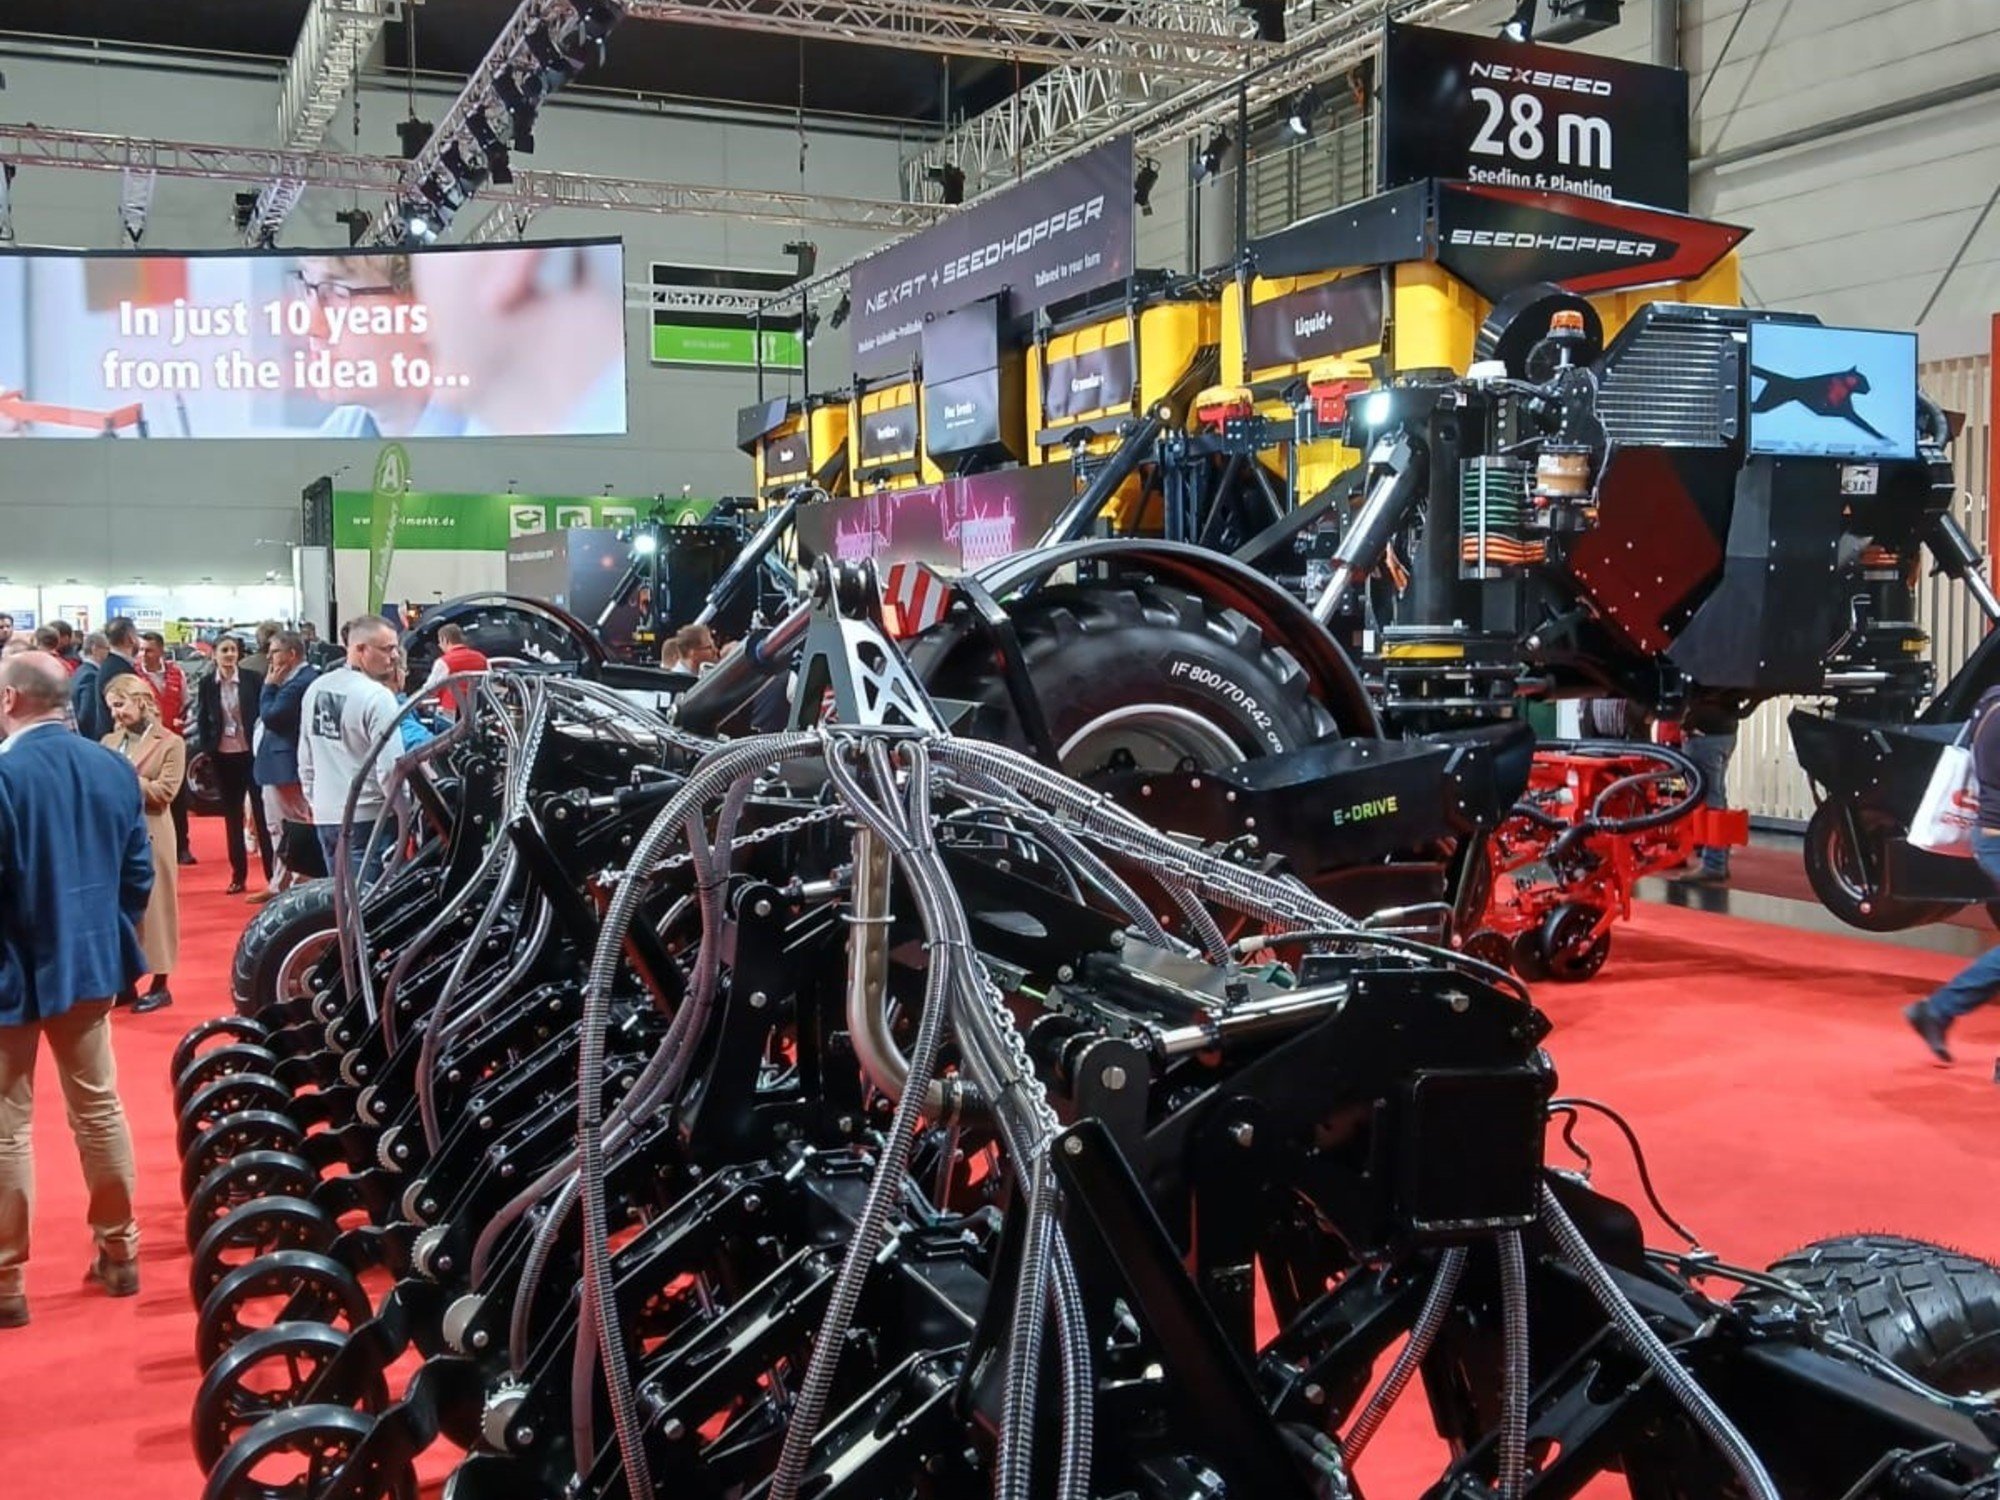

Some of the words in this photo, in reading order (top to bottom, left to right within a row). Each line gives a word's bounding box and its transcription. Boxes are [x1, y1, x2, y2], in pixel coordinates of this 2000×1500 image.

[1469, 61, 1613, 96] NEXSEED
[1469, 87, 1544, 160] 28
[1557, 113, 1613, 170] m
[865, 274, 927, 316] NEXAT
[943, 195, 1105, 285] SEEDHOPPER
[1450, 229, 1657, 257] SEEDHOPPER
[119, 301, 159, 336] In
[170, 299, 249, 346] just
[263, 302, 311, 336] 10
[324, 303, 428, 344] years
[102, 350, 200, 389] from
[214, 350, 280, 389] the
[294, 350, 378, 389] idea
[391, 352, 471, 389] to...
[1171, 661, 1191, 676] IF
[1189, 666, 1245, 702] 800/70
[1332, 796, 1398, 828] E-DRIVE
